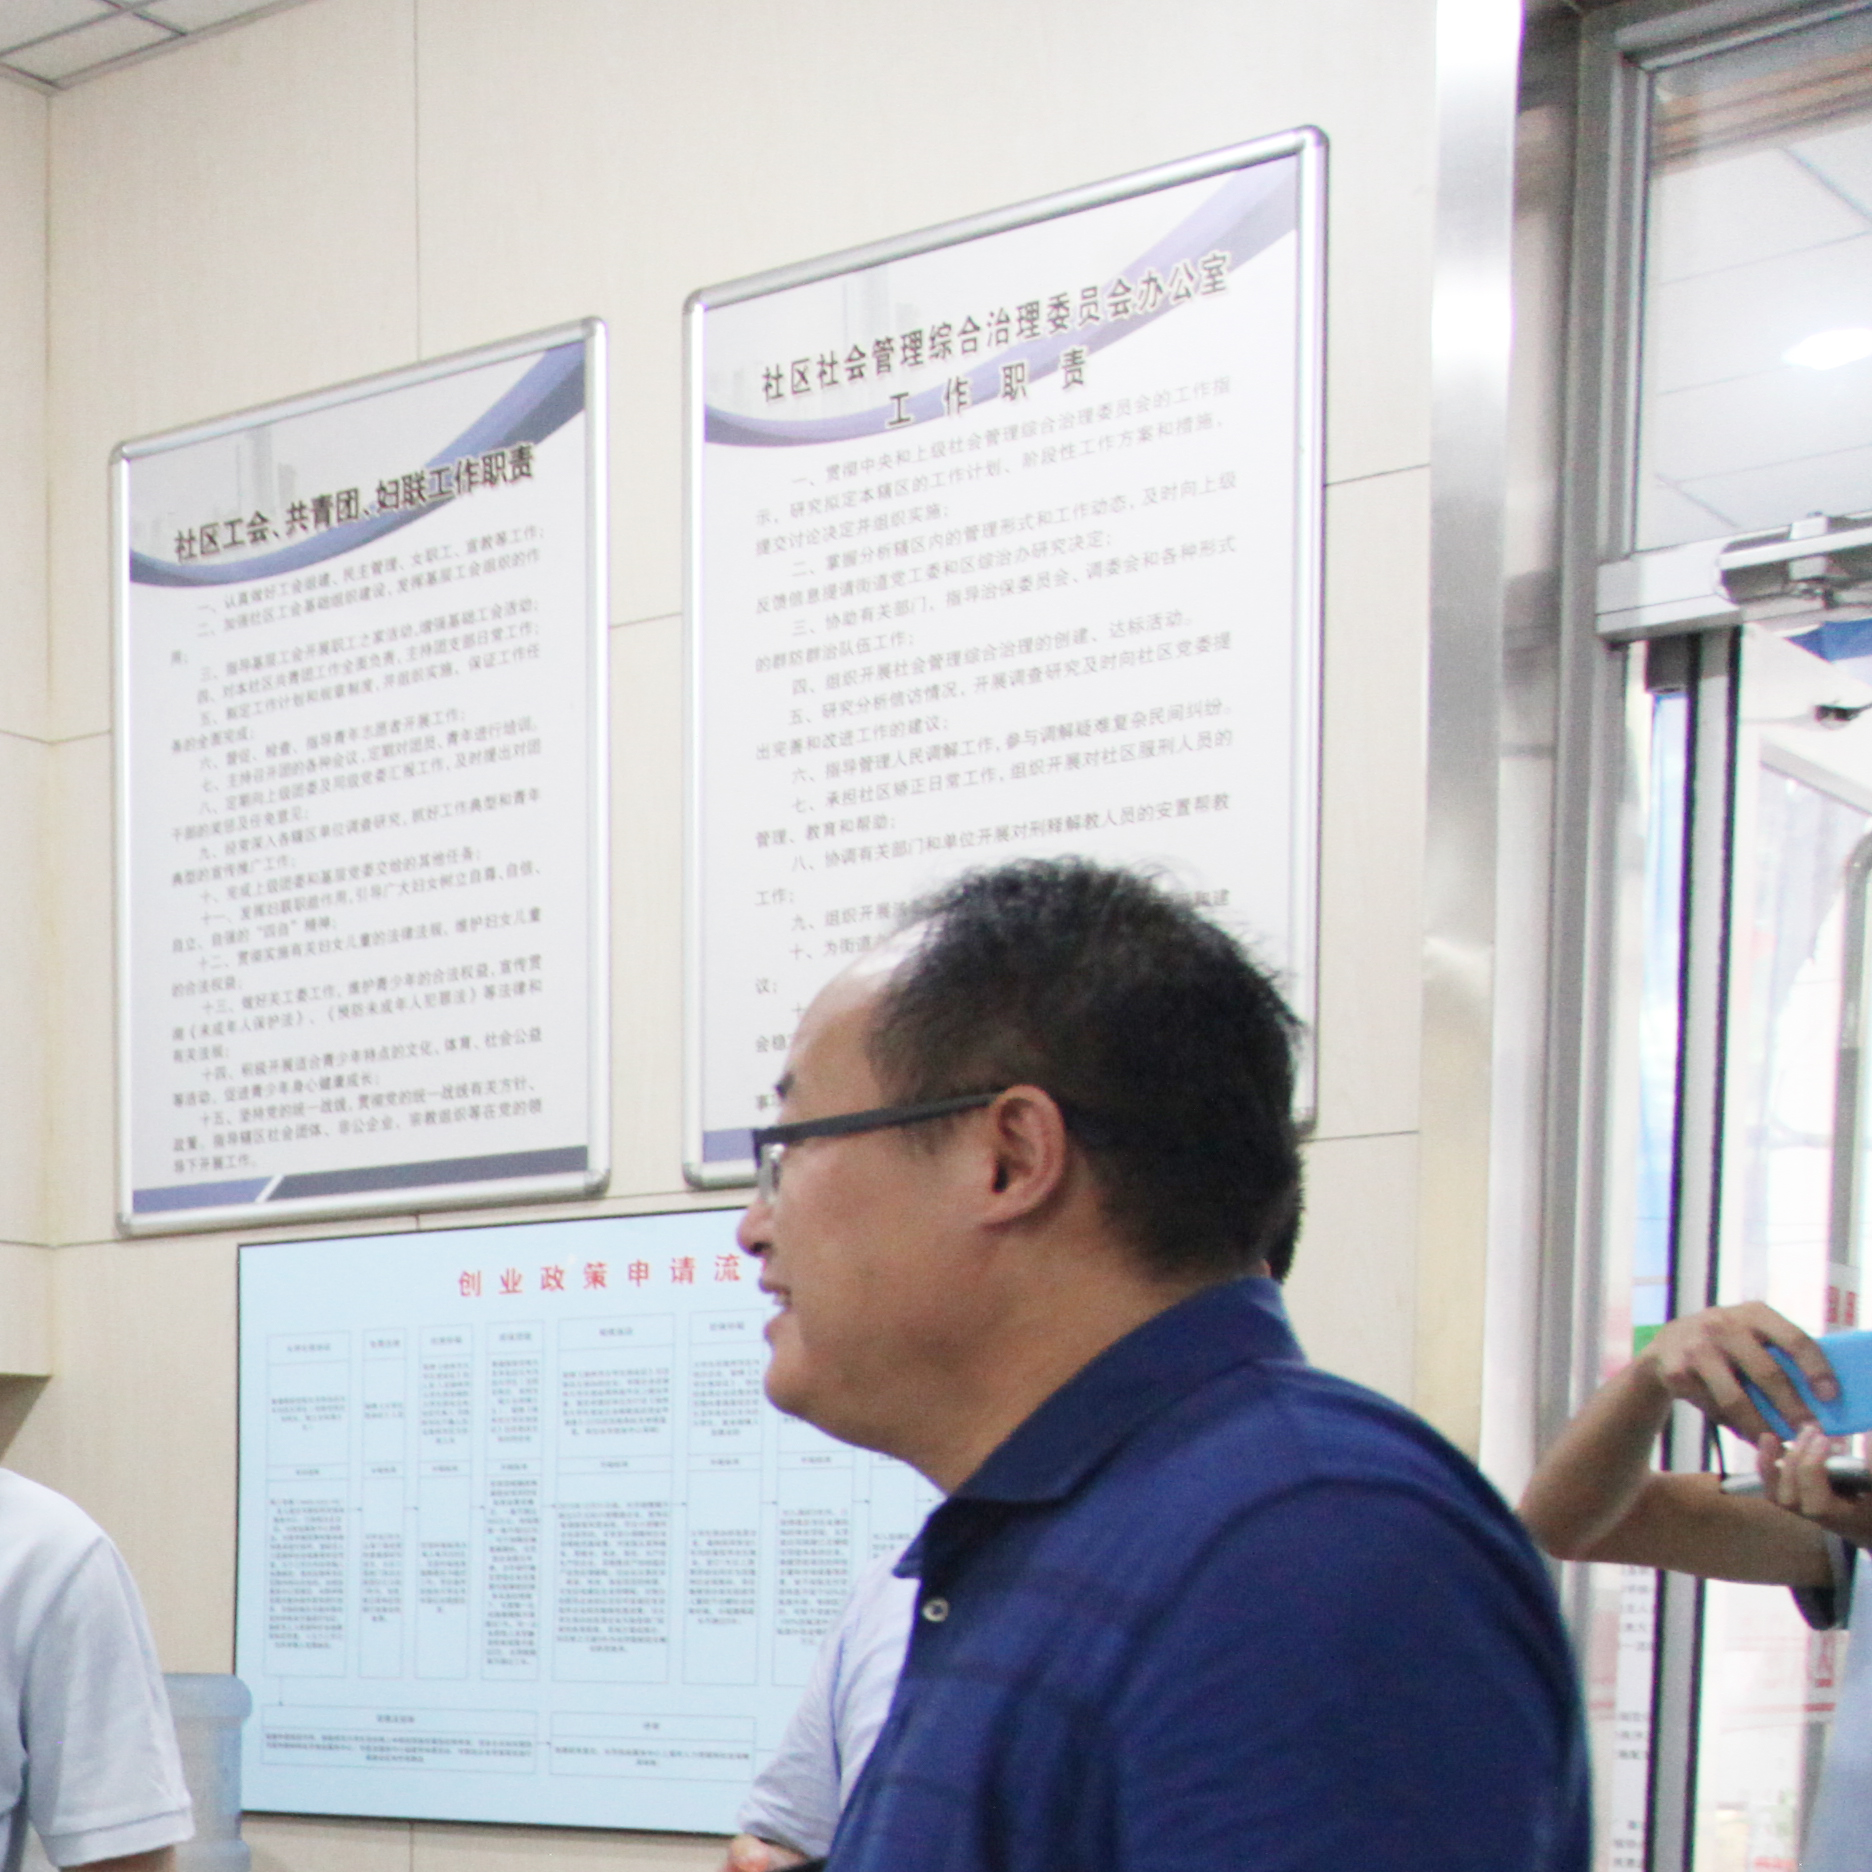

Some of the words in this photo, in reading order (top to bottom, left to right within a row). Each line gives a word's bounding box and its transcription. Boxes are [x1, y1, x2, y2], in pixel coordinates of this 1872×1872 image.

[760, 250, 1232, 404] 社区社会管理综合治理委员会办公室
[887, 346, 1089, 430] 工作职责
[173, 443, 537, 563] 社区工会、共青团、妇联工作职责
[457, 1252, 748, 1299] 创业政策申请流
